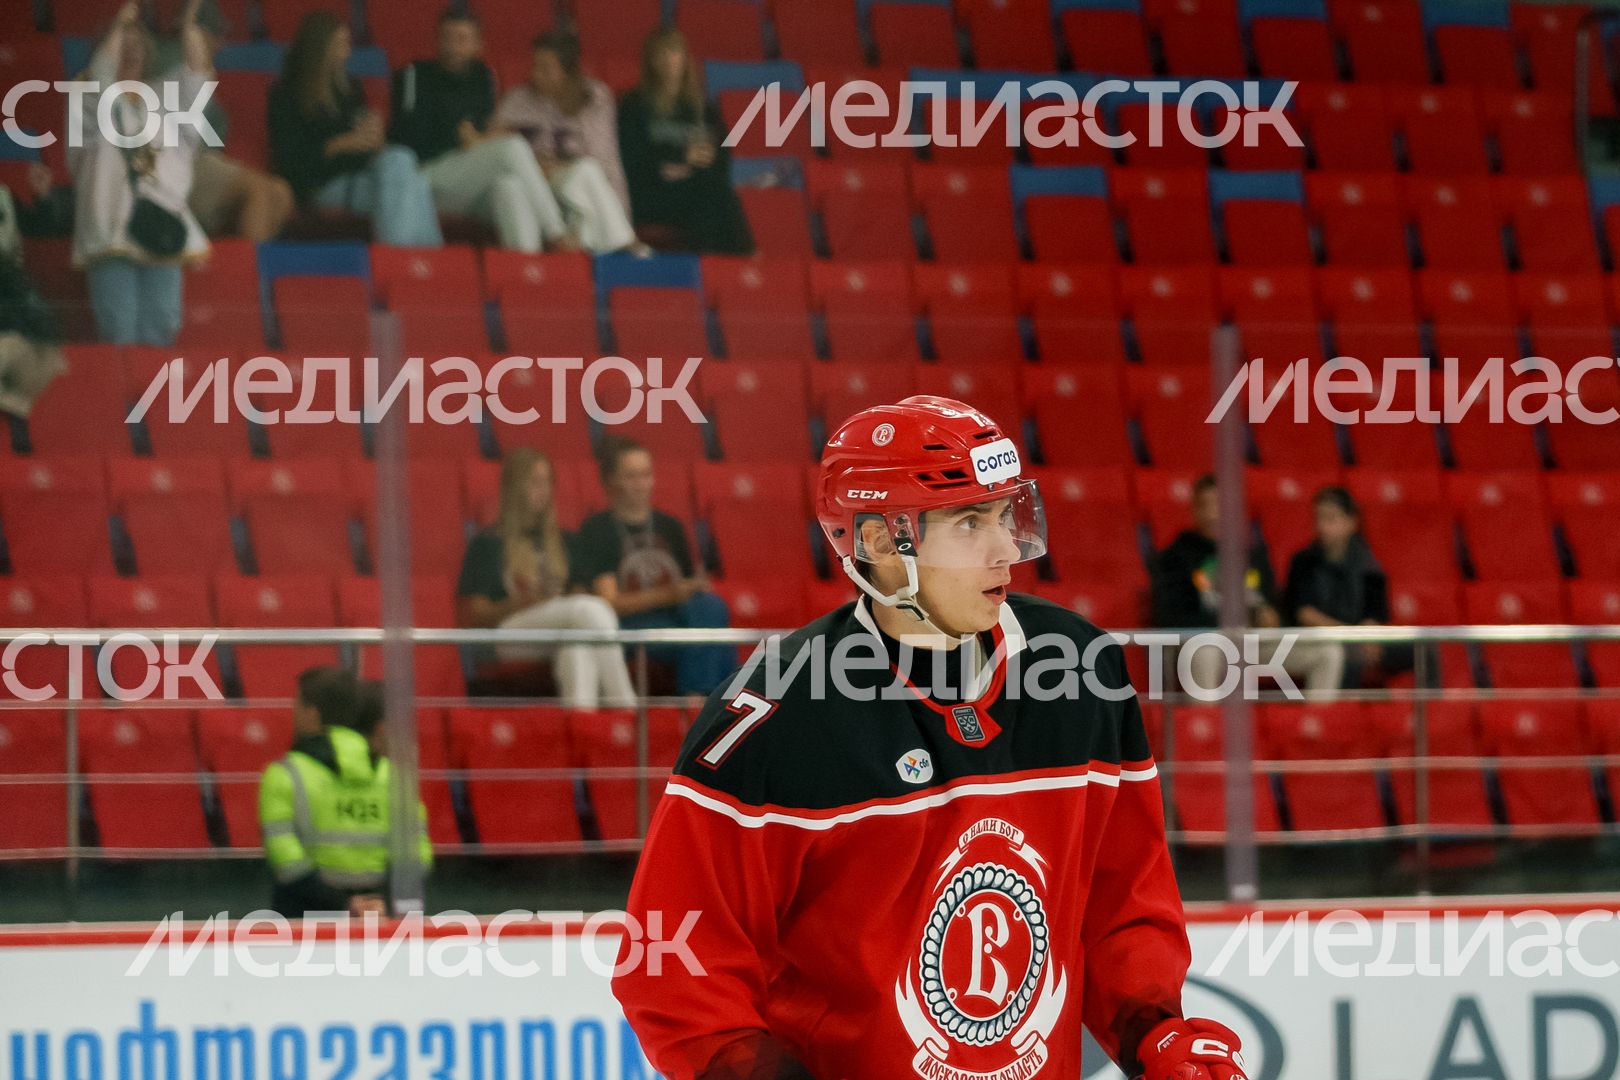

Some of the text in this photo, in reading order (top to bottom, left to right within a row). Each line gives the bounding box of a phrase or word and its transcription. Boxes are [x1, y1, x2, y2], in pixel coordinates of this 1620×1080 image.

[976, 450, 1018, 473] согаз
[847, 489, 888, 500] CCM
[970, 819, 997, 839] НАМИ
[999, 821, 1019, 841] БОГ
